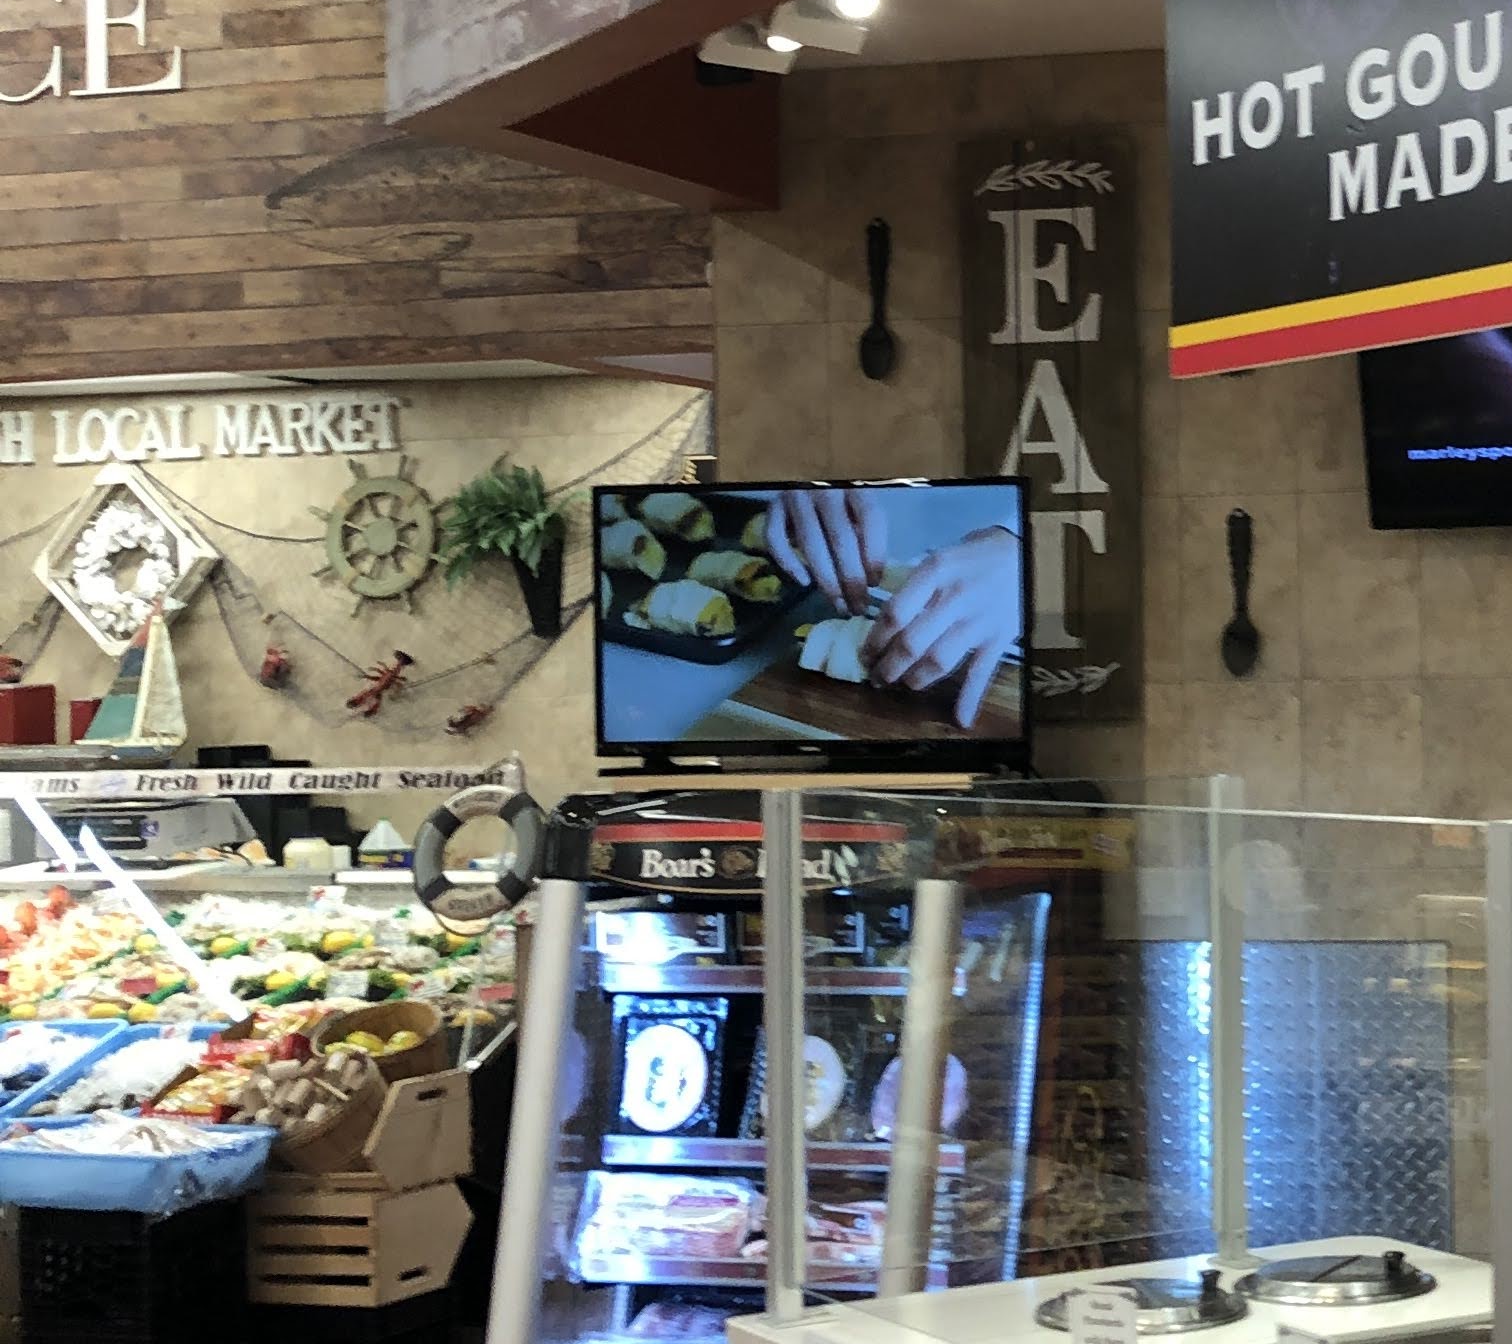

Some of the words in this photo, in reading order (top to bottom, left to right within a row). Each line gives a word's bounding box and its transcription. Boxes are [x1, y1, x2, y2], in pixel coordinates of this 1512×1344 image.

[1191, 64, 1326, 167] HOT
[51, 404, 202, 464] LOCAL
[212, 396, 402, 456] MARKET
[987, 205, 1109, 652] EAT
[134, 772, 198, 793] Fresh
[216, 771, 272, 791] Wild
[288, 769, 383, 792] Caught
[640, 847, 717, 880] Boar's
